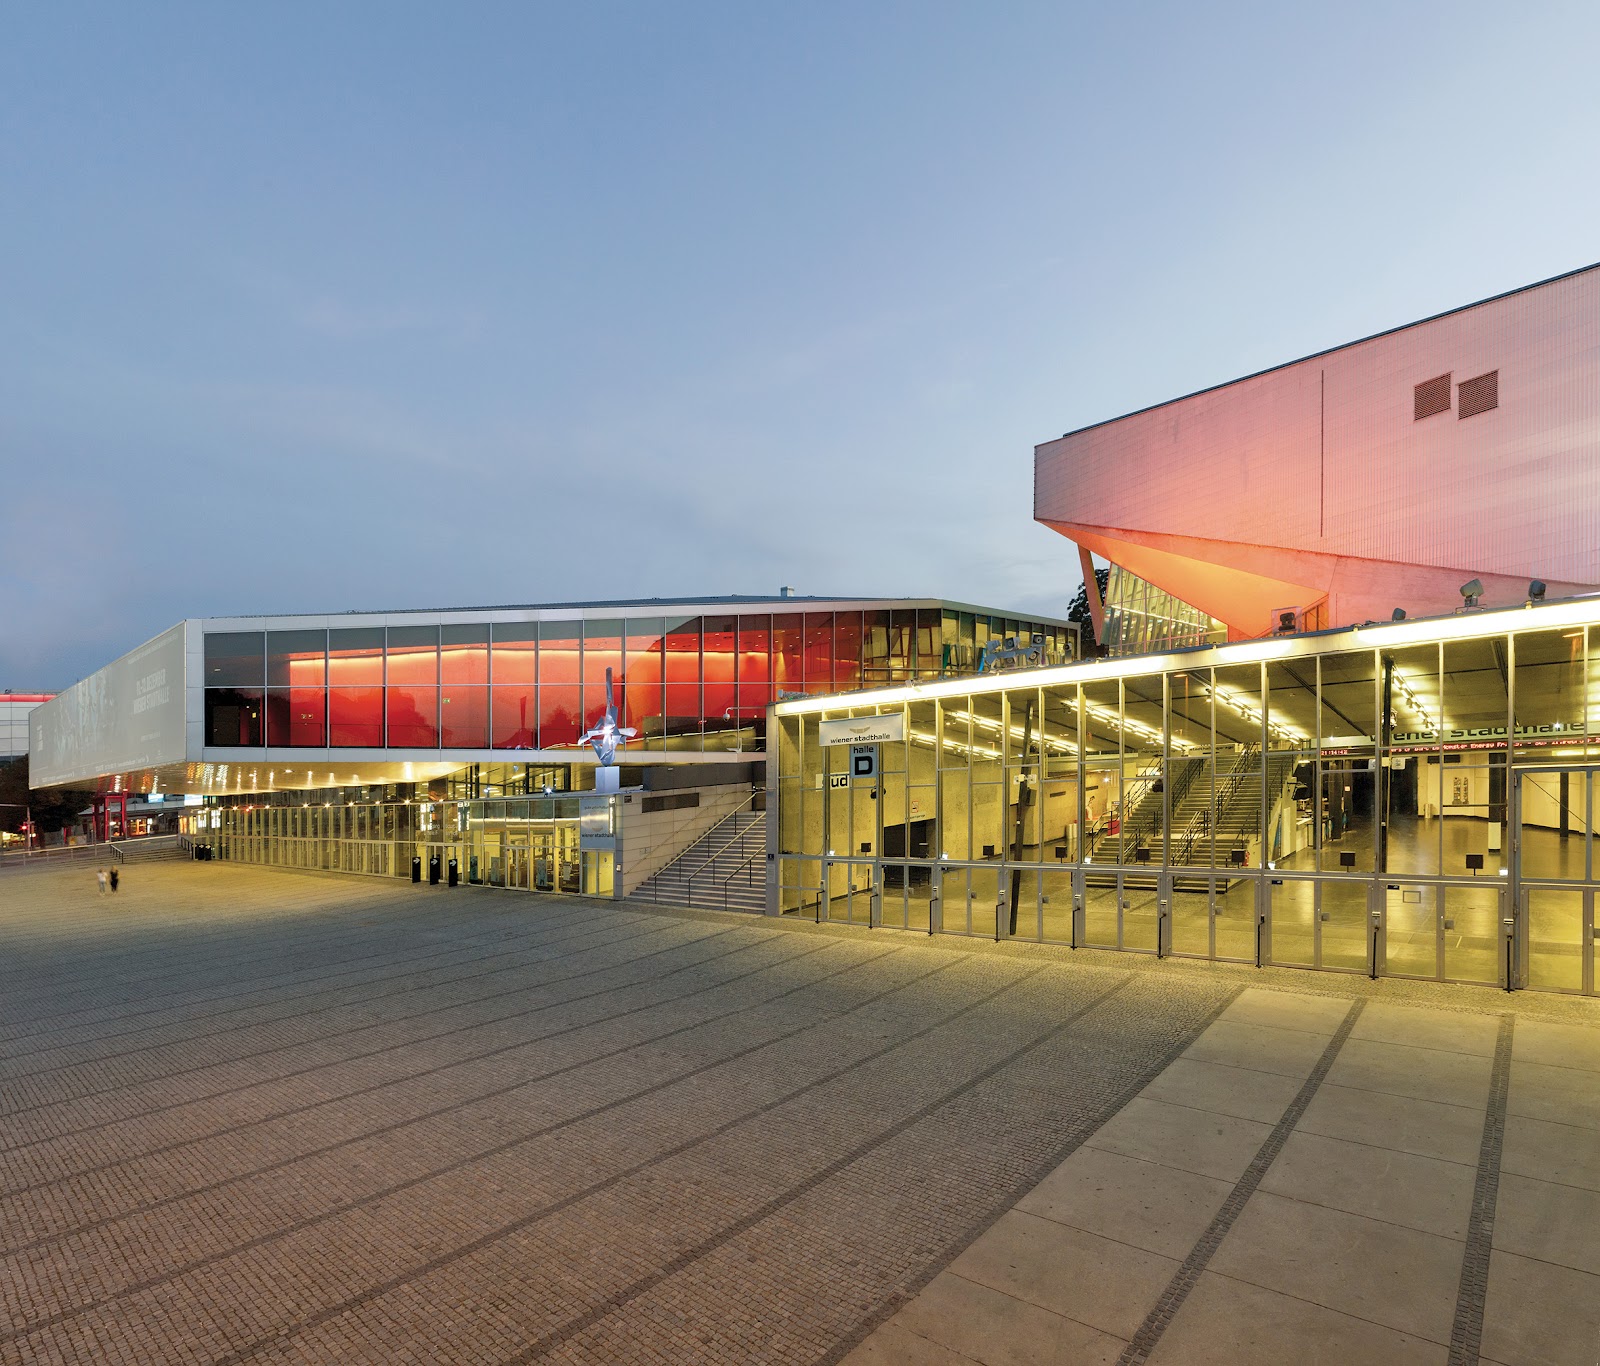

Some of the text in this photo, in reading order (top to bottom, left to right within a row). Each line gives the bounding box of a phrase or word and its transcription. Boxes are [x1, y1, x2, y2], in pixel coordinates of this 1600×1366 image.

[830, 732, 891, 744] wiener stadthalle
[853, 745, 874, 754] halle
[854, 756, 873, 775] D
